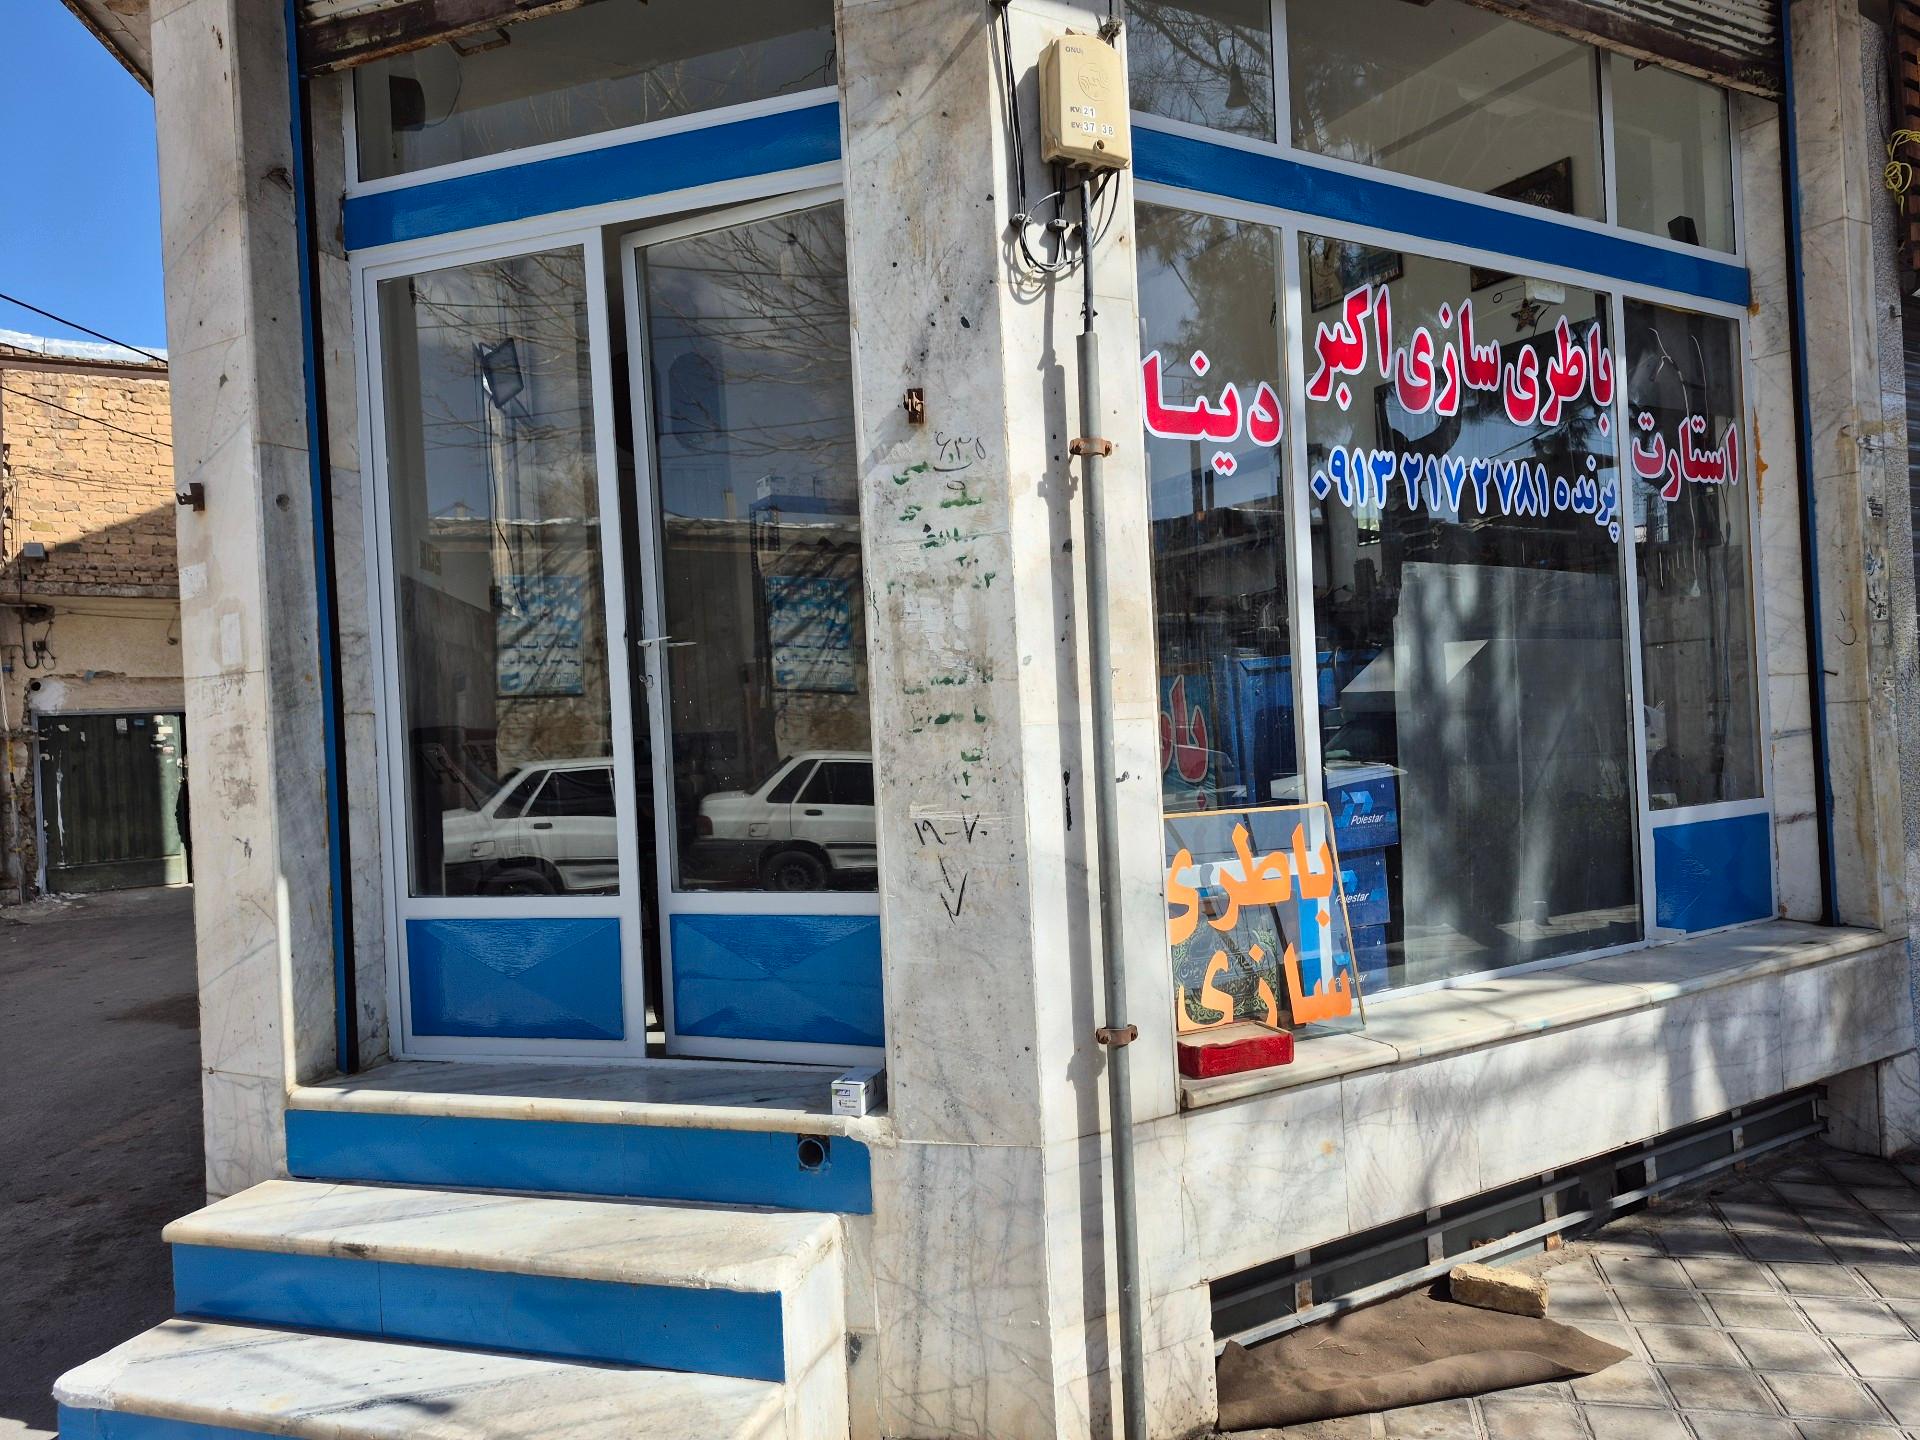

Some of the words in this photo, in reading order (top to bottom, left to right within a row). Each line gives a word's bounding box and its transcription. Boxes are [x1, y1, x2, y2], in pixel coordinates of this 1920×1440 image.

[1083, 106, 1095, 117] 21
[1083, 121, 1095, 132] 37
[1305, 283, 1392, 411] اکبر
[1395, 298, 1501, 417] سازی
[1503, 304, 1615, 437] باطری
[1631, 411, 1739, 502] استارت
[1350, 814, 1384, 826] Polestar
[1167, 823, 1334, 945] باطری
[1335, 892, 1370, 905] Plestar
[1178, 942, 1352, 1032] سازی
